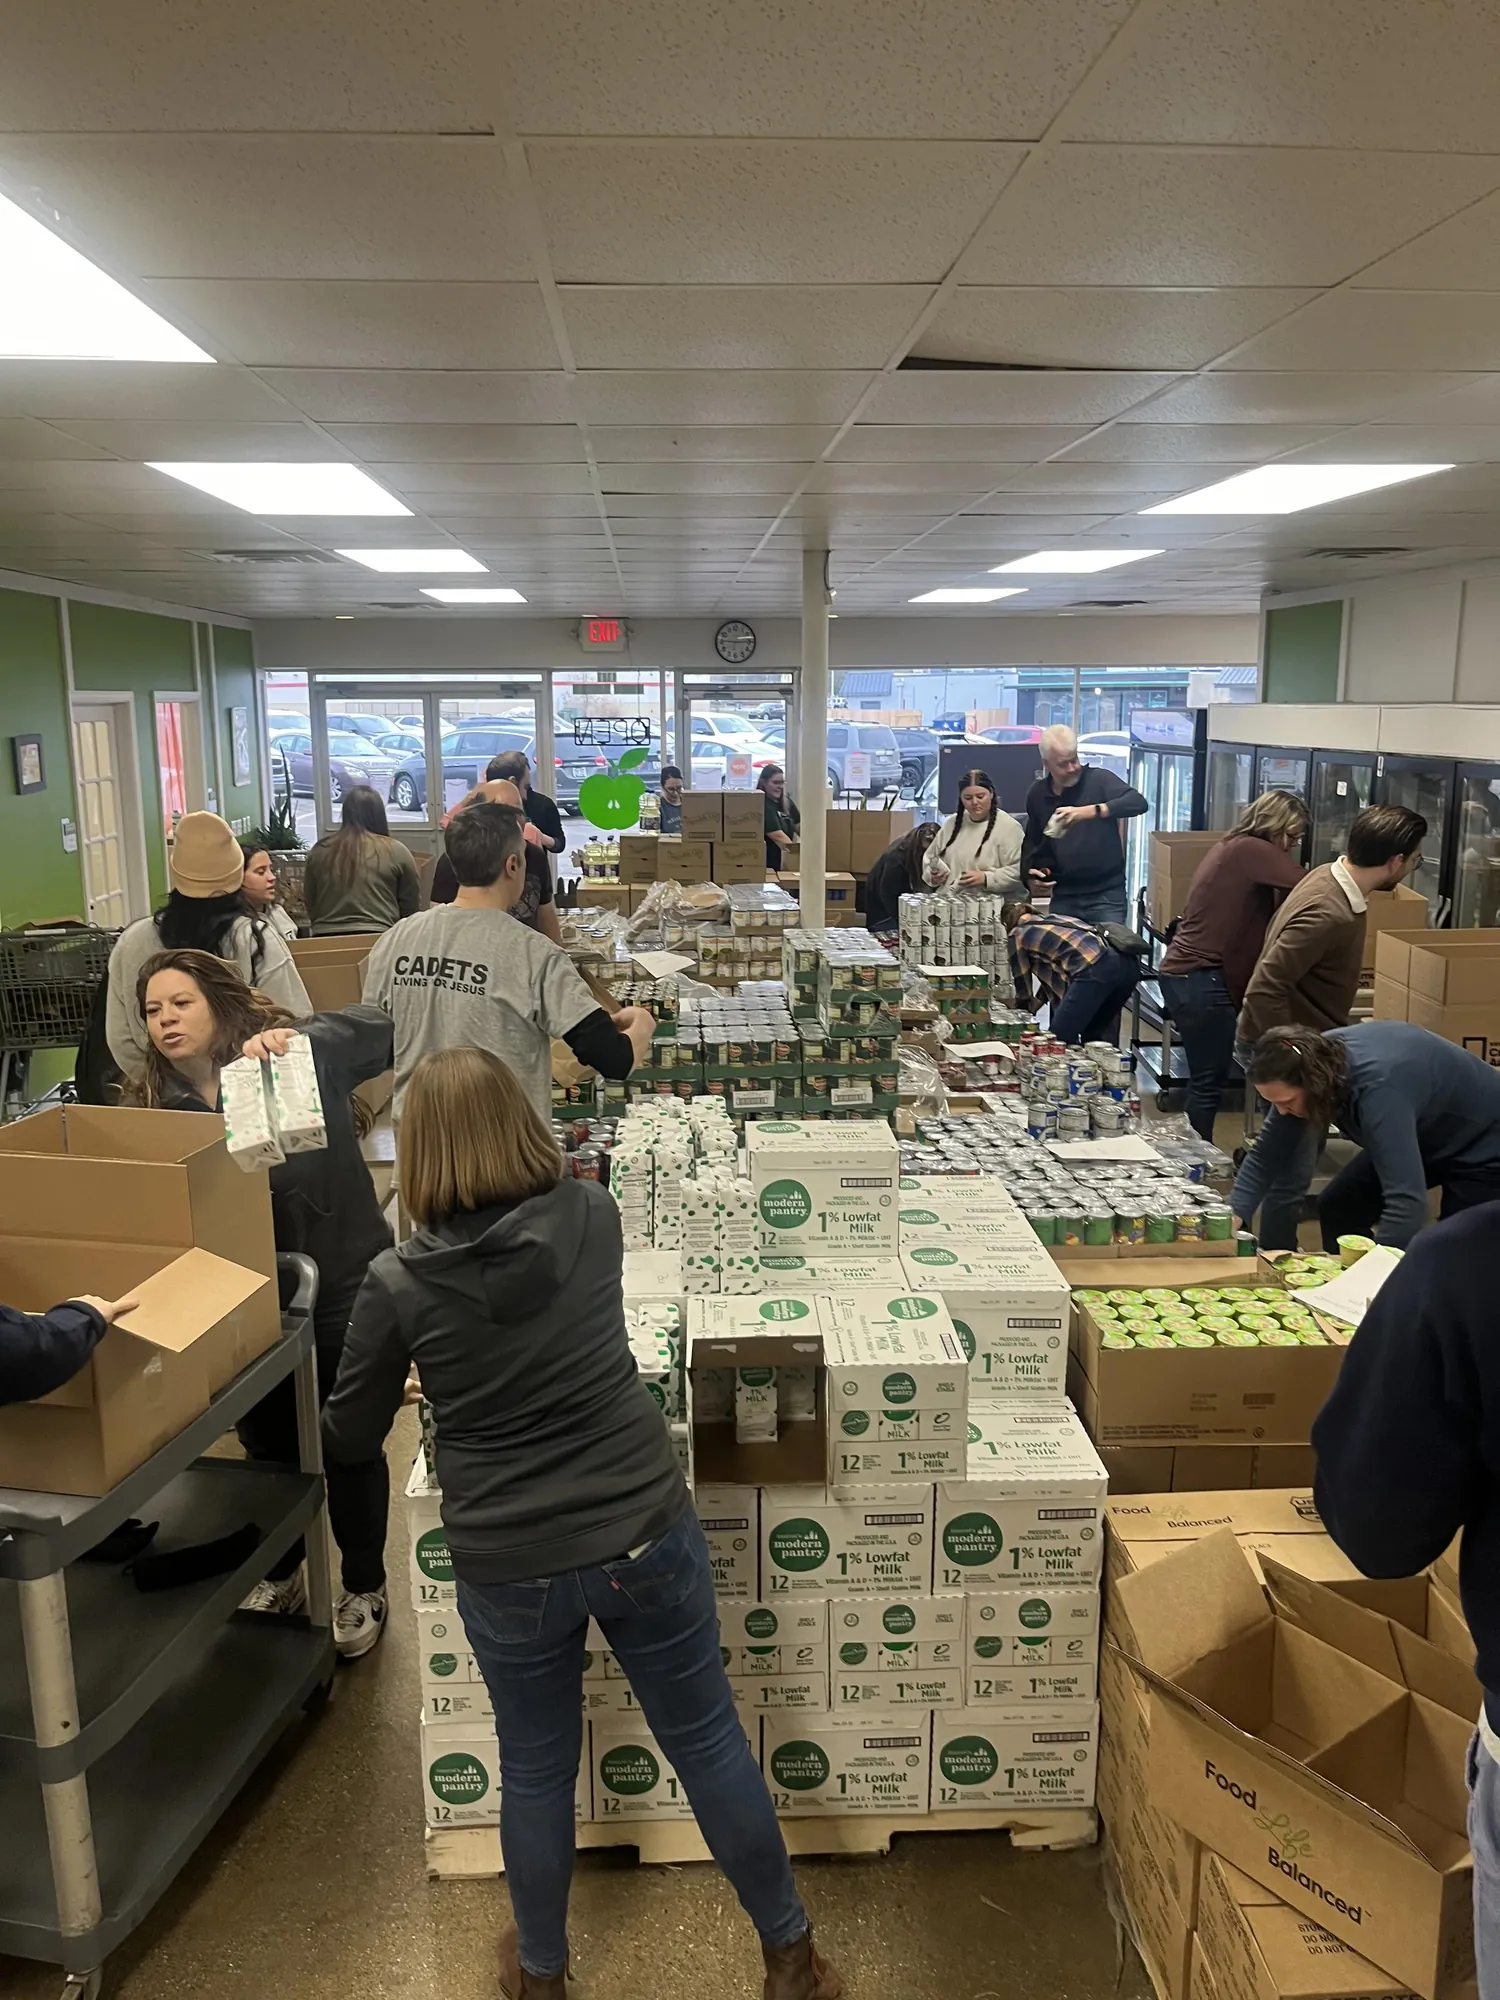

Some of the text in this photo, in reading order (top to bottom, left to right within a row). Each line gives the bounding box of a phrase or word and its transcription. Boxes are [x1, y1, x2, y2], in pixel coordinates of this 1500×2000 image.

[588, 620, 618, 643] EXIT
[394, 955, 489, 985] CADETS
[450, 981, 486, 996] JESUS
[763, 1198, 805, 1207] modern
[770, 1207, 808, 1217] pantry
[817, 1211, 882, 1232] 1% Lowfat
[850, 1223, 874, 1232] Milk
[759, 1231, 776, 1245] 12
[888, 1332, 906, 1354] Lowfat
[981, 1352, 1048, 1374] 1% Lowfat
[1015, 1364, 1041, 1374] Milk
[745, 1395, 768, 1403] MILK
[887, 1430, 910, 1438] MILK
[983, 1441, 1011, 1456] 1%
[1026, 1448, 1058, 1456] Milk
[841, 1454, 860, 1470] 12
[898, 1451, 950, 1468] 1% Lowfat
[923, 1459, 944, 1468] Milk
[1112, 1505, 1150, 1515] Food
[1167, 1515, 1232, 1528] Balanced
[773, 1539, 822, 1548] modern
[947, 1533, 996, 1543] modern
[781, 1548, 825, 1559] pantry
[954, 1543, 998, 1554] pantry
[836, 1551, 910, 1575] 1% Lowfat
[1008, 1546, 1082, 1570] 1% Lowfat
[1045, 1558, 1074, 1570] Milk
[873, 1563, 902, 1574] Milk
[770, 1575, 788, 1590] 12
[942, 1569, 961, 1584] 12
[419, 1585, 438, 1600] 12
[886, 1659, 910, 1667] MILK
[1021, 1653, 1044, 1662] MILK
[896, 1680, 946, 1698] 1% Lowfat
[974, 1679, 992, 1694] 12
[1029, 1677, 1078, 1693] 1% Lowfat
[760, 1685, 810, 1702] 1% Lowfat
[785, 1694, 806, 1702] Milk
[841, 1685, 860, 1700] 12
[921, 1689, 942, 1697] Milk
[432, 1697, 450, 1712] 12
[775, 1760, 822, 1769] modern
[944, 1755, 990, 1764] modern
[604, 1765, 652, 1774] modern
[782, 1769, 824, 1779] pantry
[951, 1763, 992, 1774] pantry
[434, 1773, 481, 1782] modern
[612, 1773, 654, 1784] pantry
[836, 1771, 908, 1794] 1% Lowfat
[1004, 1766, 1076, 1788] 1% Lowfat
[1039, 1778, 1067, 1788] Milk
[442, 1782, 484, 1792] pantry
[872, 1783, 900, 1794] Milk
[1205, 1759, 1256, 1811] Food
[772, 1793, 790, 1806] 12
[939, 1787, 958, 1800] 12
[602, 1798, 620, 1812] 12
[433, 1806, 452, 1820] 12
[1267, 1845, 1362, 1926] Balanced
[1302, 1935, 1318, 1944] DO
[1307, 1944, 1345, 1955] DO NOT
